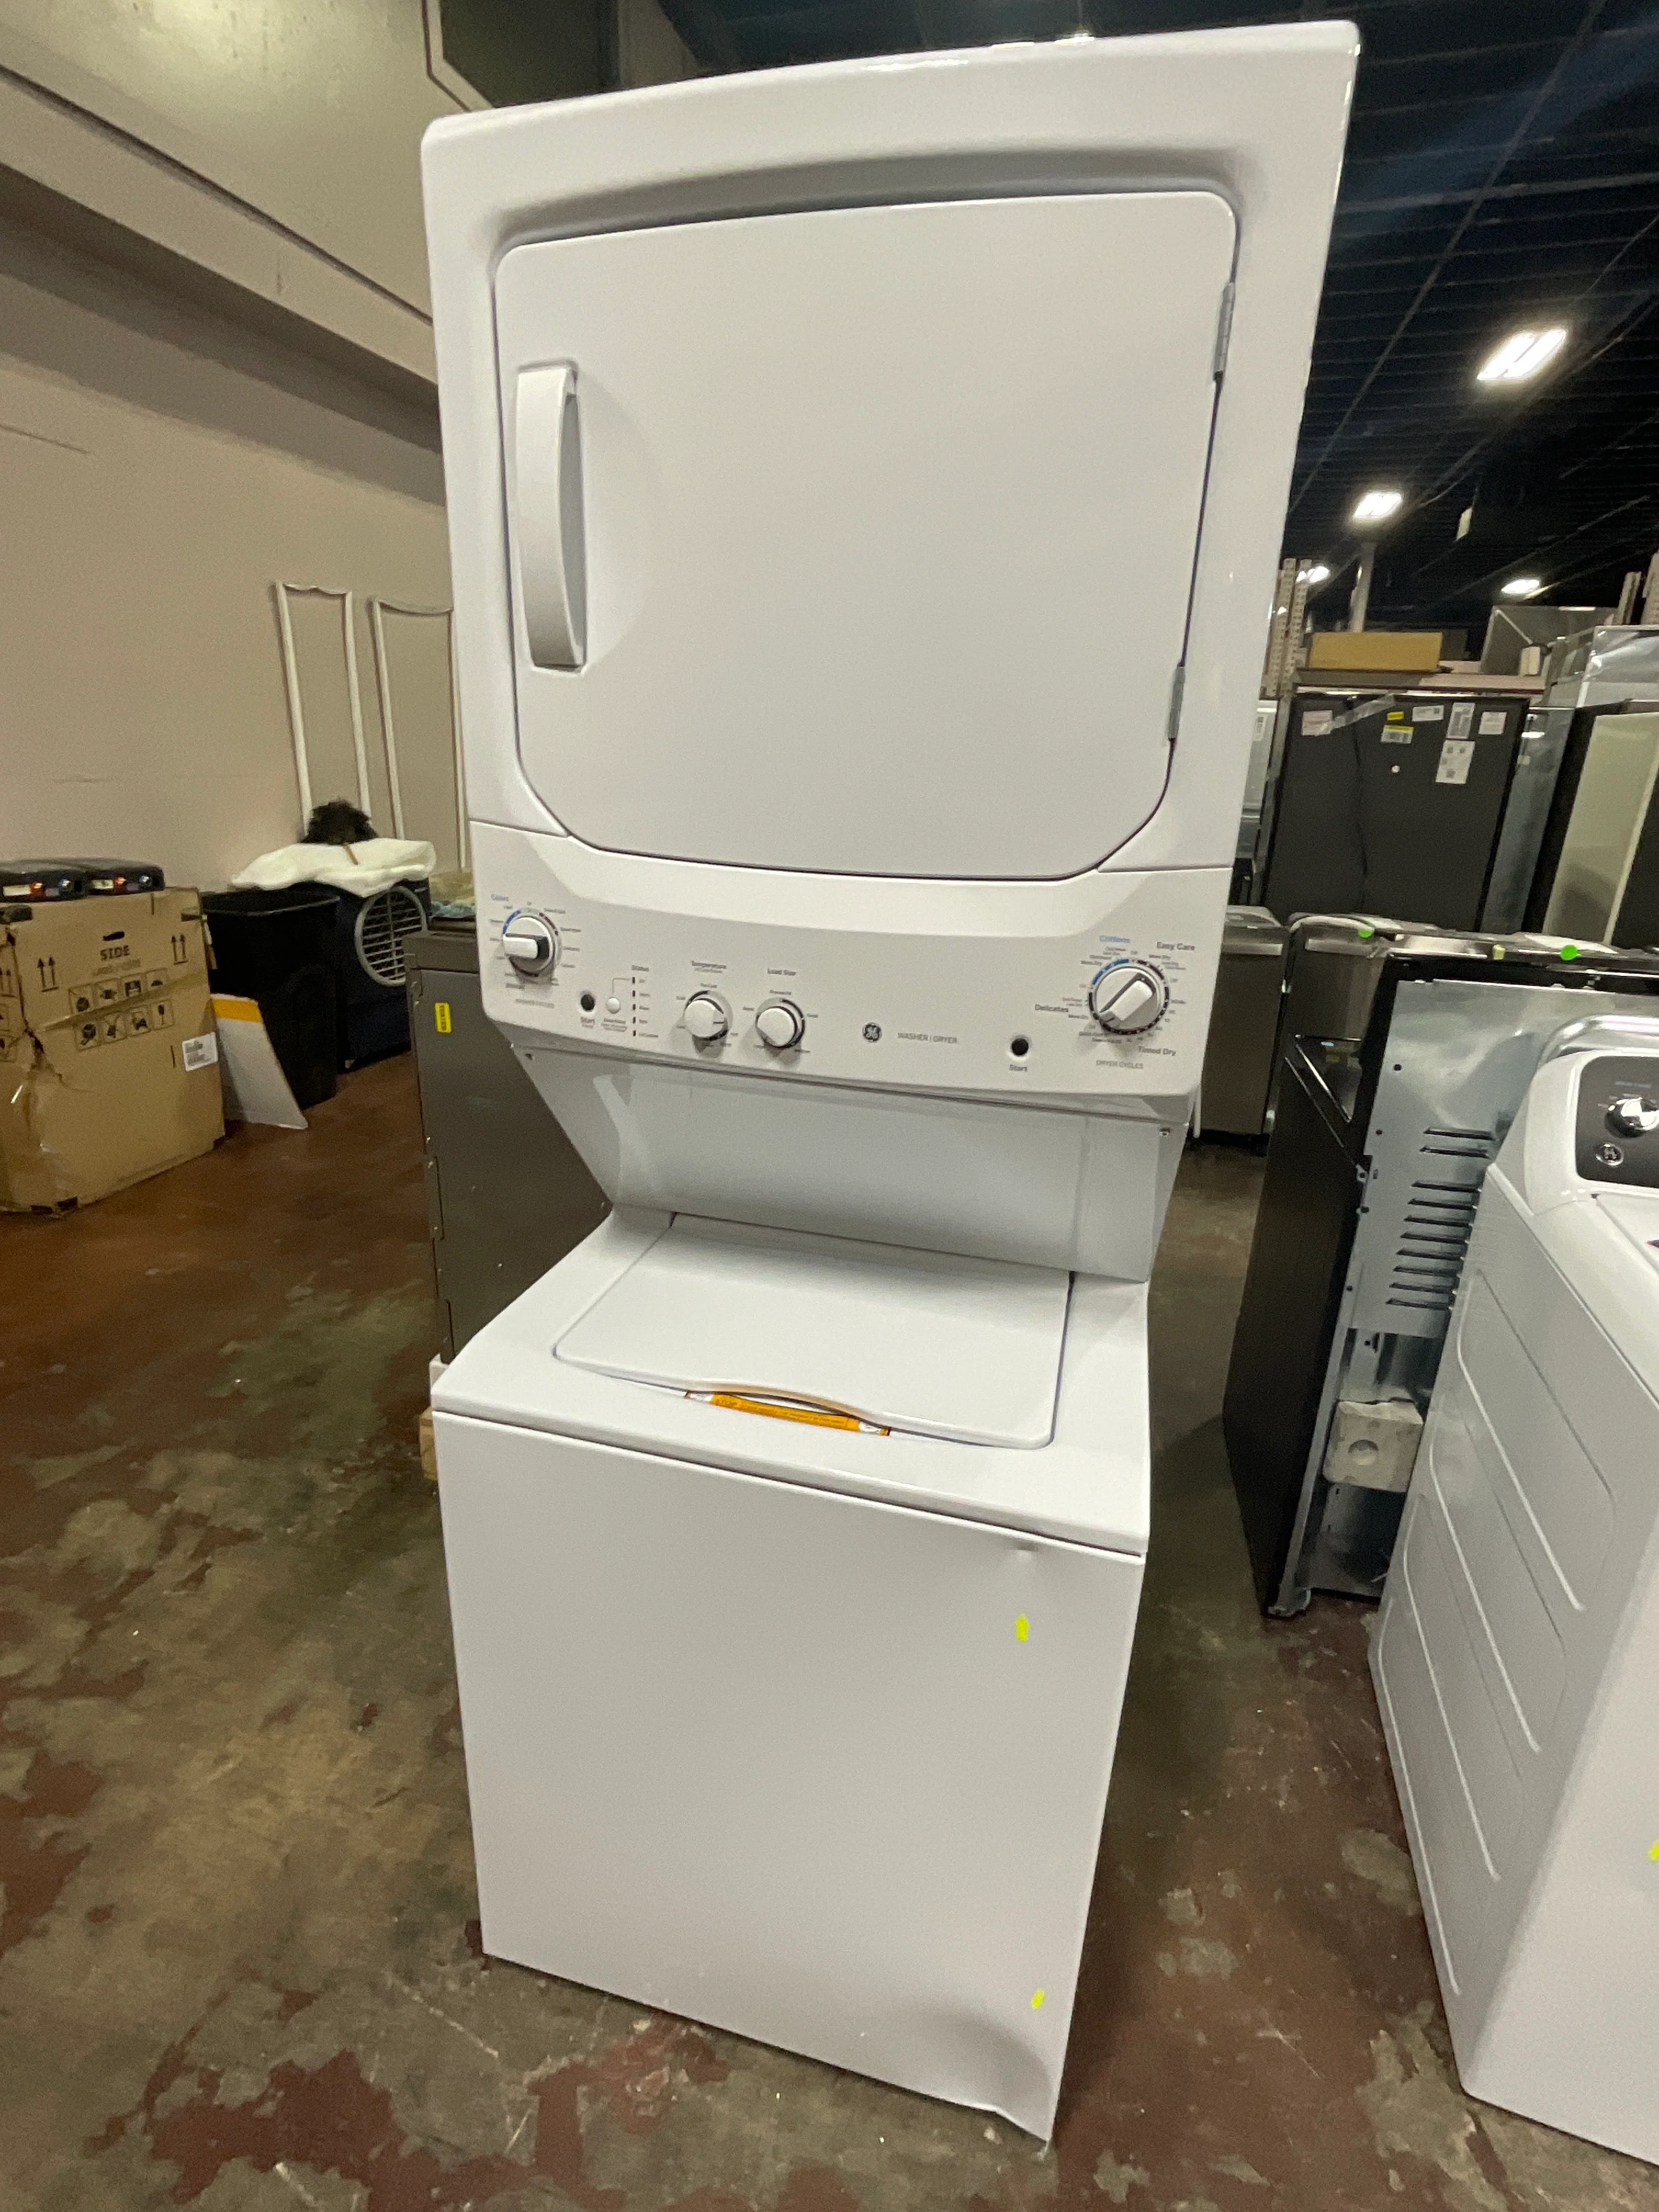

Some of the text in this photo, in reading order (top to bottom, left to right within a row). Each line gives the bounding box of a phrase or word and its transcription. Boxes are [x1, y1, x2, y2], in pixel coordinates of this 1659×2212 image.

[1157, 941, 1175, 951] Easy
[100, 945, 130, 962] SIDE
[1035, 1004, 1069, 1013] Delicates
[898, 1032, 957, 1043] WASHER DRYER
[1163, 1048, 1176, 1057] Dry
